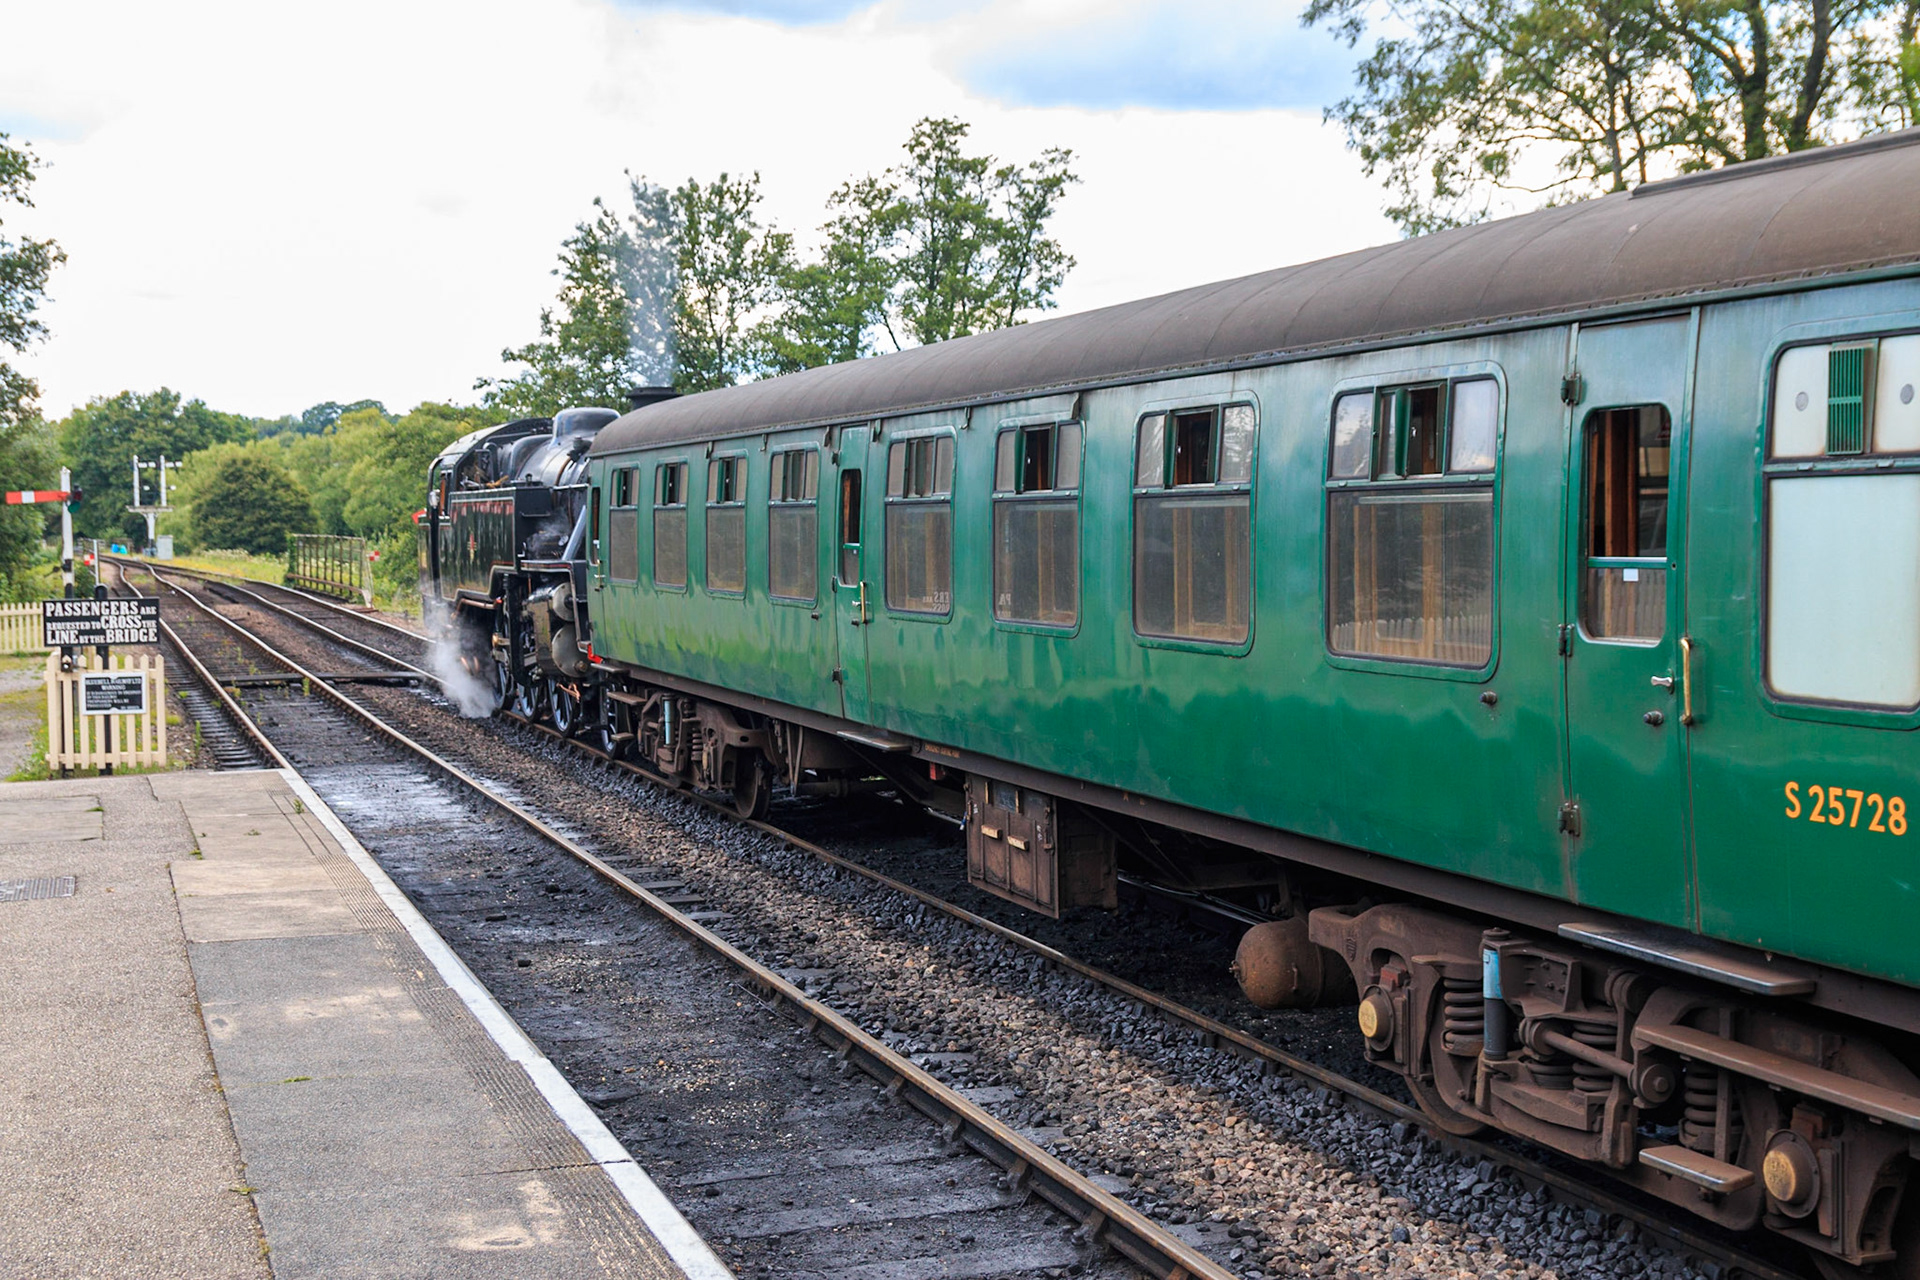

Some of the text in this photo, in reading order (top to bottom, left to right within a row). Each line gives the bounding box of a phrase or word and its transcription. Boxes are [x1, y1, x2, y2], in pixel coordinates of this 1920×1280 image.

[45, 601, 157, 617] PASSENGERS ARE
[46, 615, 157, 630] REQUESTED TO CROSS THE
[46, 628, 158, 645] LINE BY THE BRIDGE
[1784, 781, 1908, 836] S 25728
